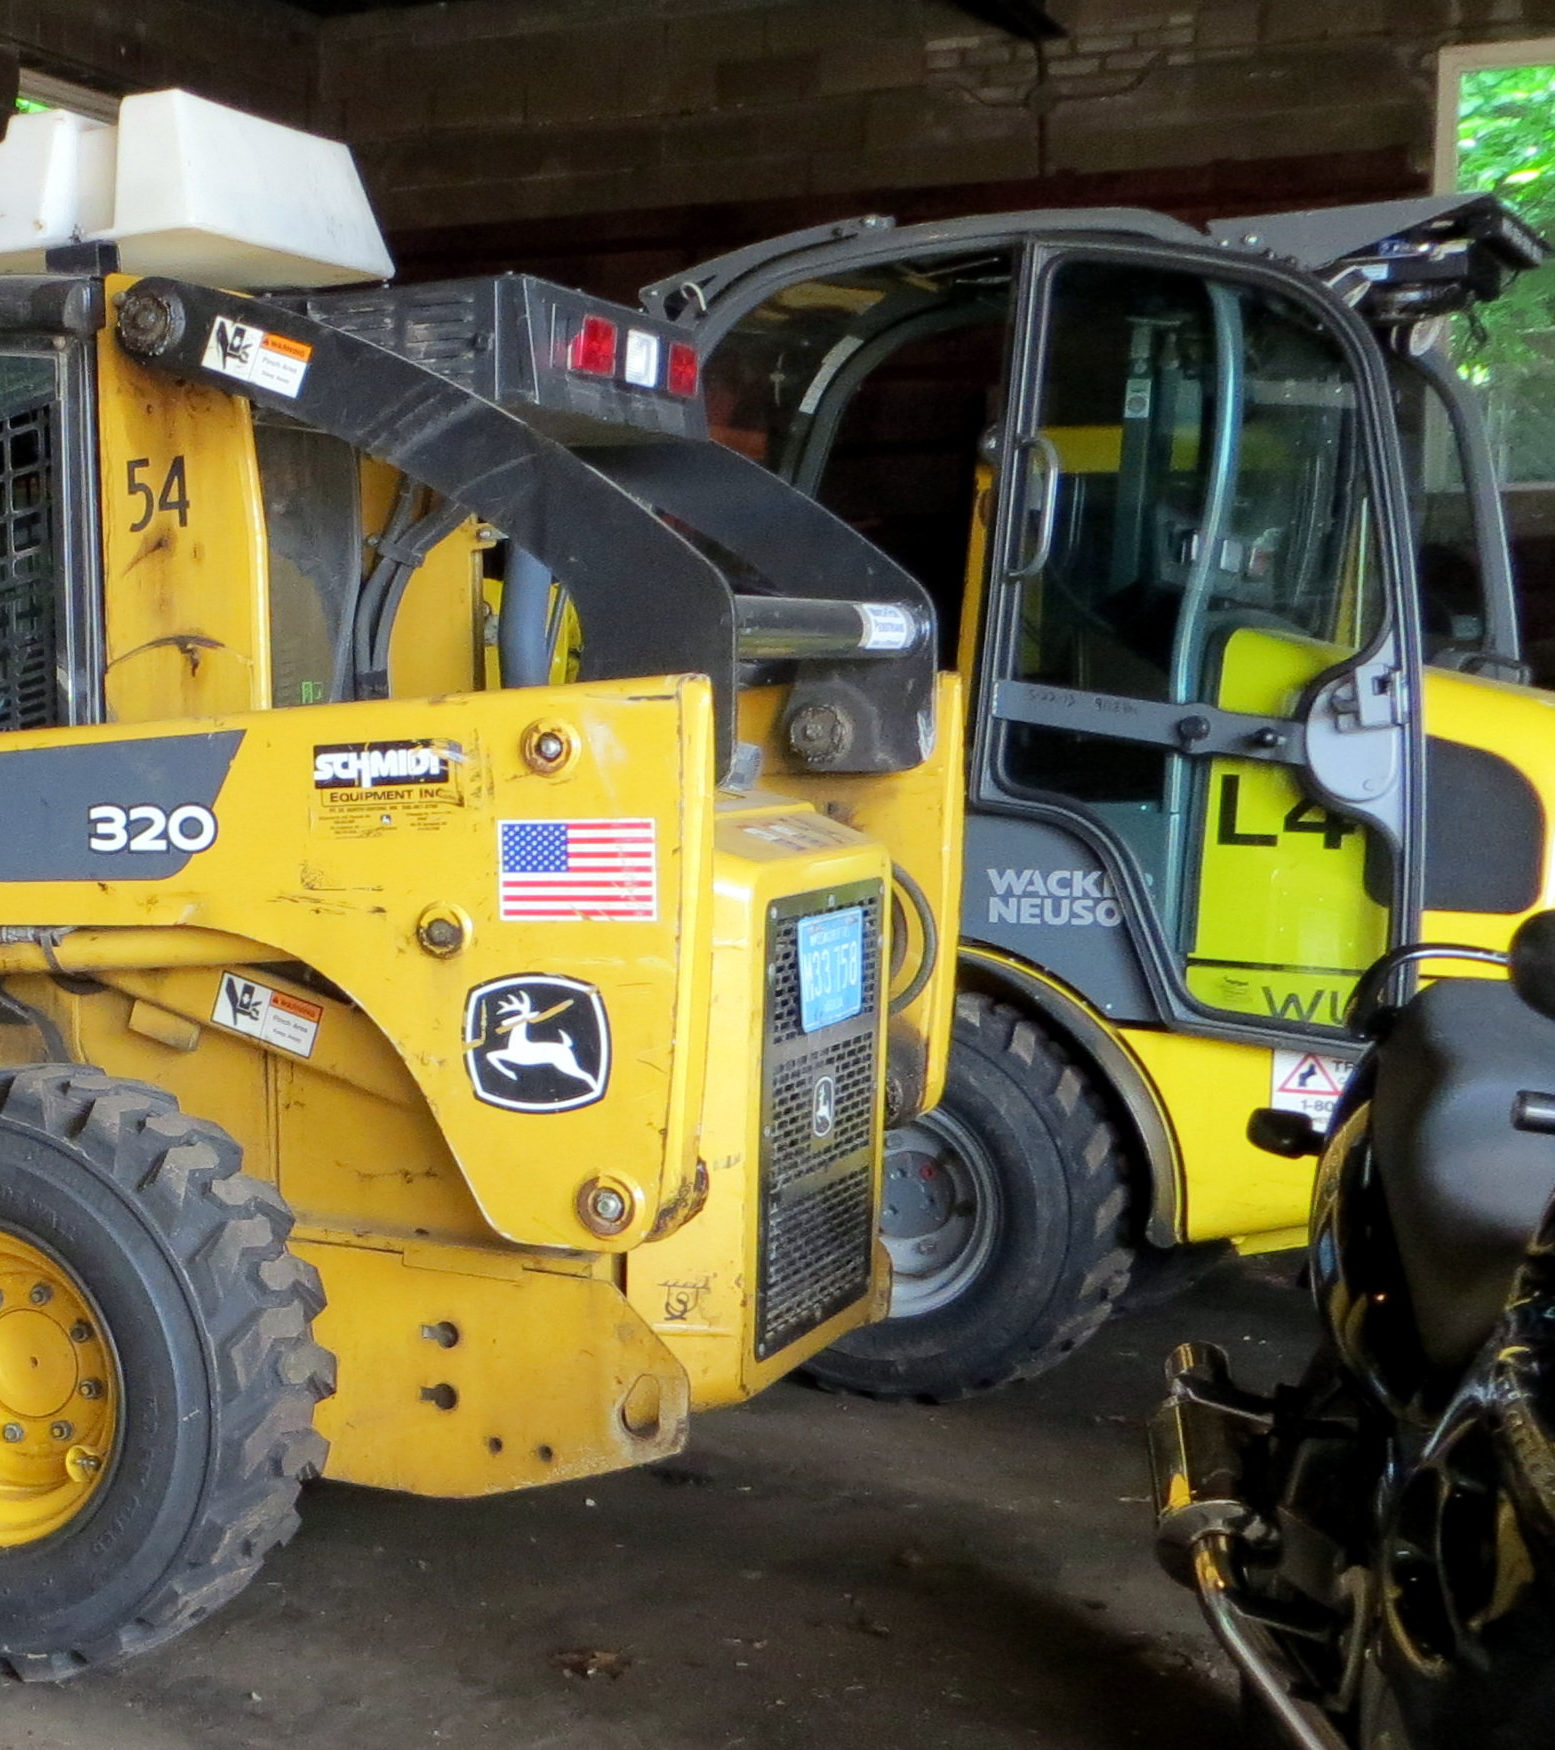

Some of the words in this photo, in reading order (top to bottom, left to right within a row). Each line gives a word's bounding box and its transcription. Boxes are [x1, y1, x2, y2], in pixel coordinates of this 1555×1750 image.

[126, 455, 190, 532] 54
[314, 748, 441, 788] SCHMIDT
[329, 789, 414, 803] EQUIPMENT
[88, 803, 218, 854] 320
[987, 868, 1116, 898] WACK
[988, 896, 1123, 927] NEUSO
